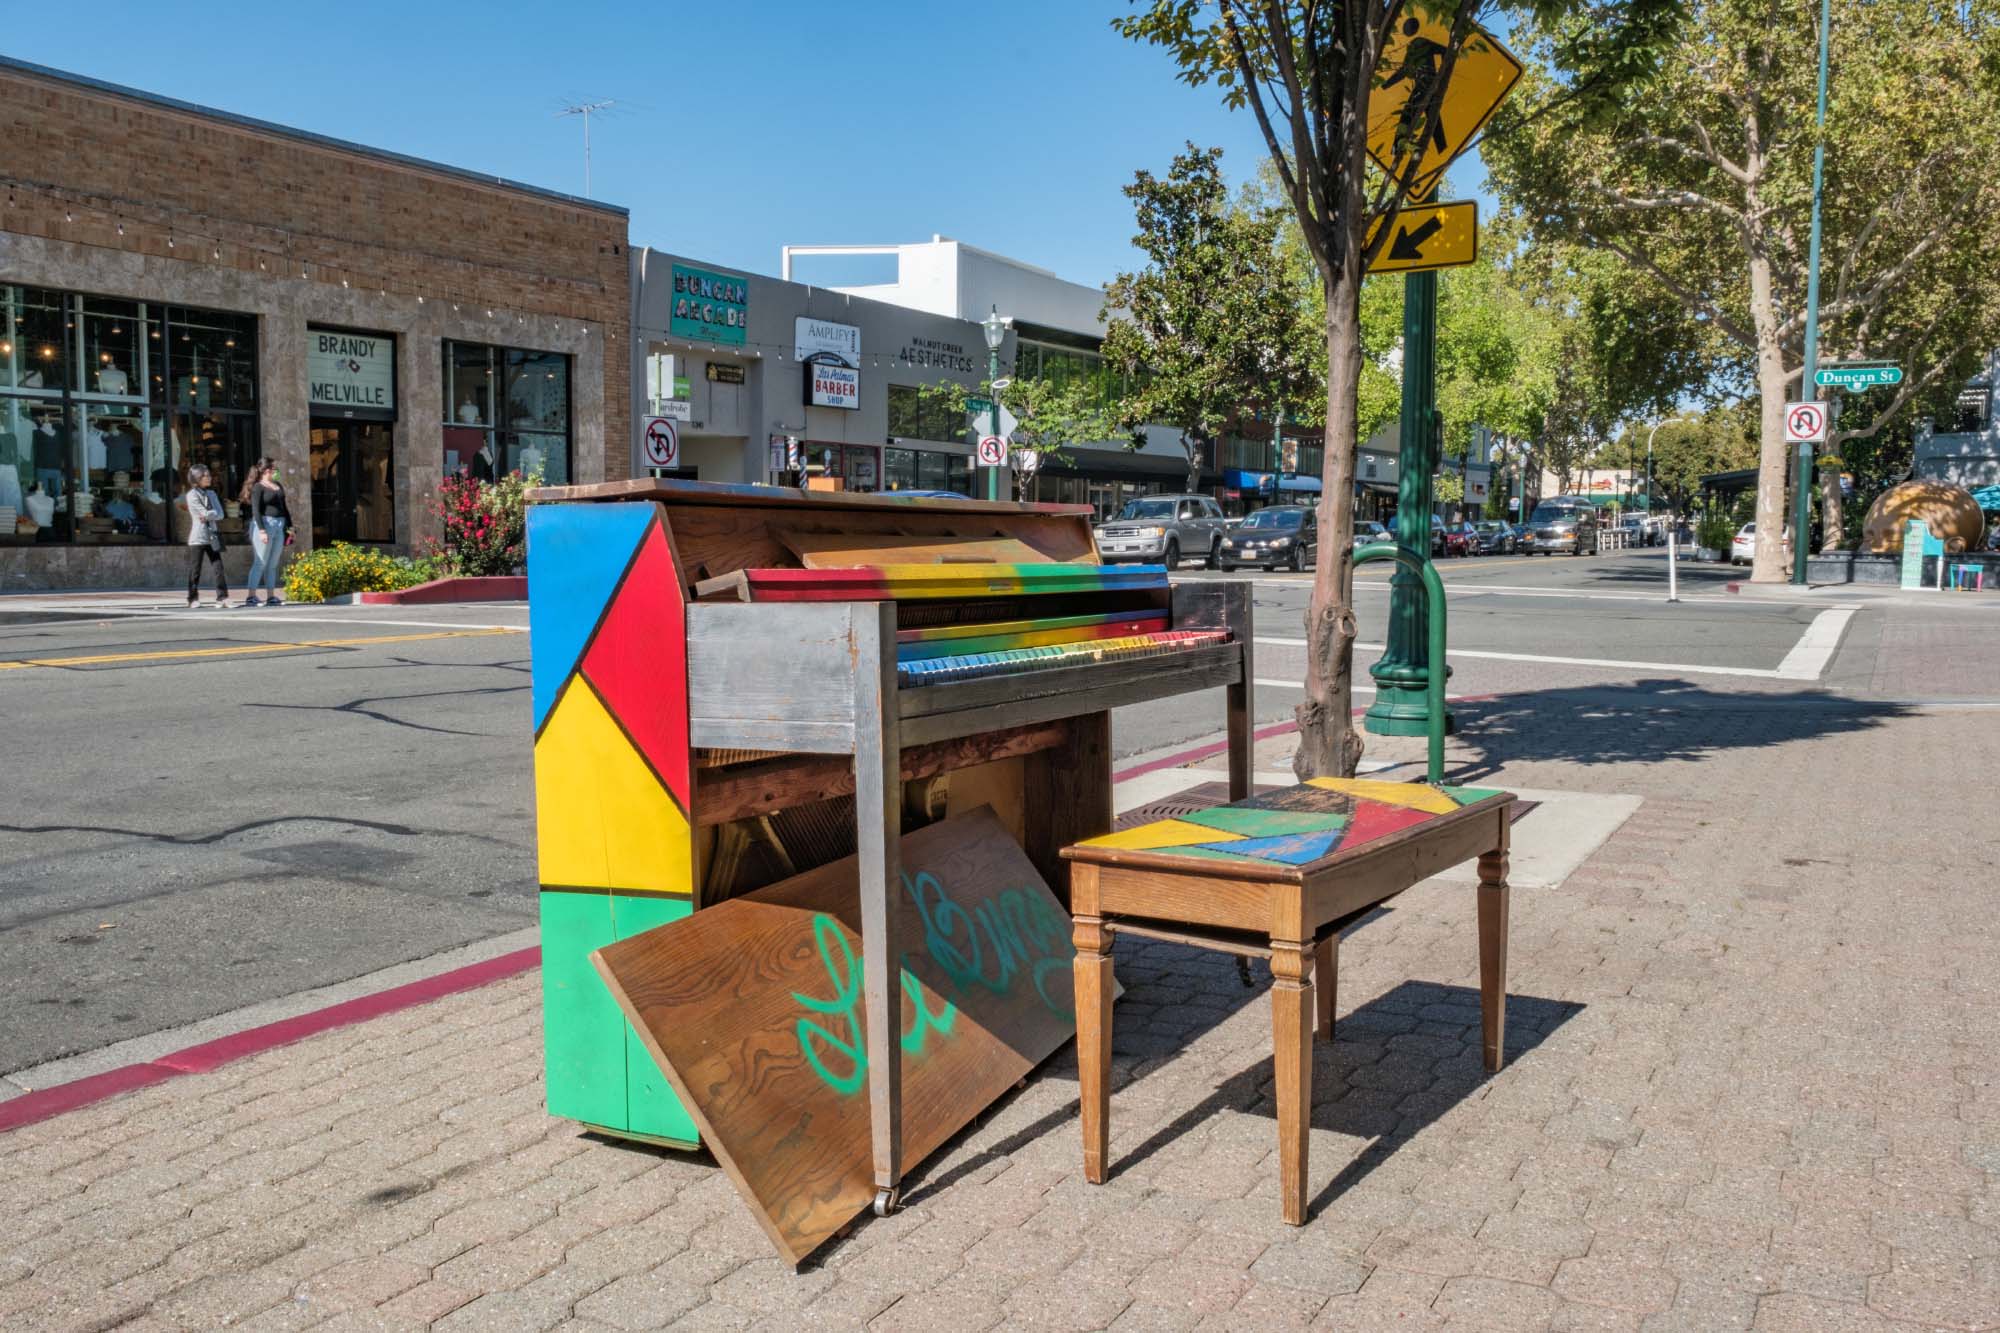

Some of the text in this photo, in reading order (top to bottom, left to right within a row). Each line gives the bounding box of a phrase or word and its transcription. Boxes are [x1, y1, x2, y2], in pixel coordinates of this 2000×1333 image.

[674, 272, 746, 305] DUNCAN
[674, 299, 747, 328] ARCADE
[808, 322, 849, 342] AMPLIFY
[319, 335, 376, 358] BRANDY
[912, 336, 963, 354] WALNUT CREEK
[899, 346, 973, 372] AESTHETICS
[1822, 371, 1894, 383] Duncan St
[312, 382, 385, 405] MELVILLE
[815, 380, 856, 397] BARBER
[652, 401, 688, 413] ardrobe
[827, 395, 845, 404] SHOP
